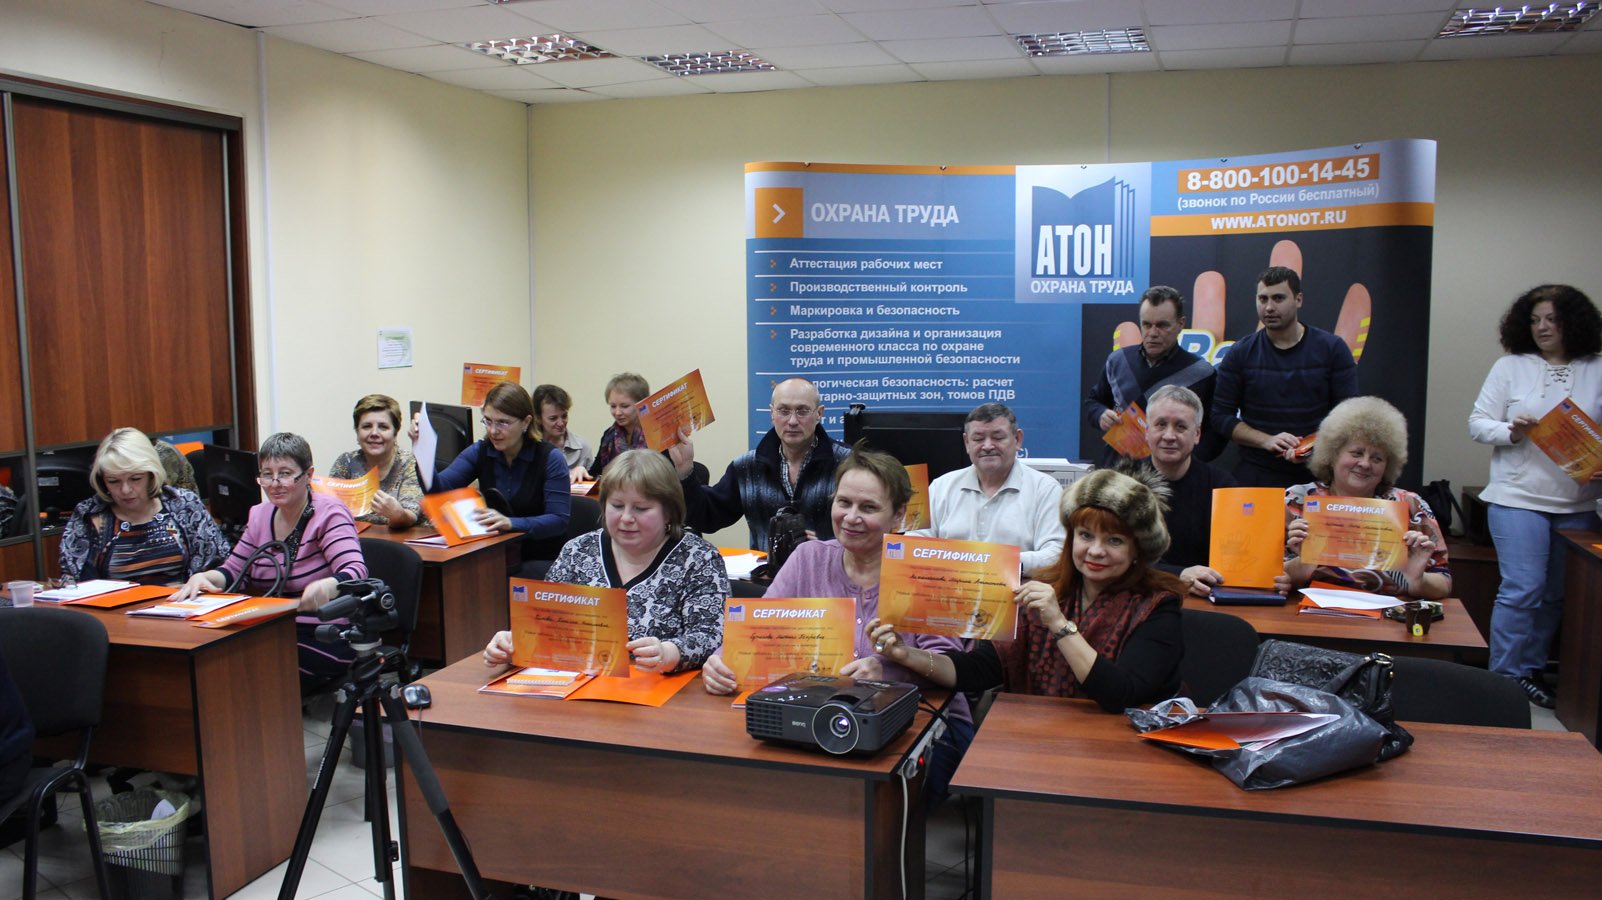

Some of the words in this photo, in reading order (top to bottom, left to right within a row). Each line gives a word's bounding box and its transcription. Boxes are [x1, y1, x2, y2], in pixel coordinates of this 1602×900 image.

[1187, 158, 1370, 191] 8-800-100-14-45
[1177, 196, 1228, 211] (звонок
[1231, 195, 1247, 206] по
[1249, 190, 1296, 205] России
[1298, 182, 1380, 202] бесплатный)
[811, 203, 890, 223] ОХРАНА
[895, 204, 960, 227] ТРУДА
[1210, 210, 1348, 230] WWW.ATONOT.RU
[1035, 223, 1112, 276] АТОН
[789, 257, 858, 271] Аттестация
[860, 257, 911, 272] рабочих
[914, 260, 943, 270] мест
[790, 280, 907, 294] Производственный
[910, 282, 968, 295] контроль
[1030, 280, 1087, 294] ОХРАНА
[1089, 280, 1134, 296] ТРУДА
[790, 304, 863, 318] Маркировка
[866, 306, 874, 315] и
[876, 303, 960, 316] безопасность
[790, 327, 858, 341] Разработка
[860, 328, 910, 341] дизайна
[913, 330, 921, 338] и
[924, 329, 1002, 341] организация
[790, 342, 875, 355] современного
[878, 342, 920, 352] класса
[922, 342, 938, 351] по
[941, 342, 984, 354] охране
[790, 356, 824, 368] труда
[826, 356, 835, 365] и
[837, 352, 932, 367] промышленной
[935, 352, 1020, 365] безопасности
[812, 378, 879, 390] логическая
[881, 376, 969, 389] безопасность:
[972, 378, 1014, 389] расчет
[651, 382, 689, 409] СЕРТИФИКАТ
[820, 390, 917, 404] тарно-защитных
[919, 391, 944, 402] зон,
[947, 390, 985, 401] томов
[988, 389, 1016, 402] ПДВ
[1326, 502, 1386, 515] СЕРТИФИКАТ
[912, 547, 992, 564] СЕРТИФИКАТ
[534, 590, 601, 607] СЕРТИФИКАТ
[752, 608, 827, 619] СЕРТИФИКАТ
